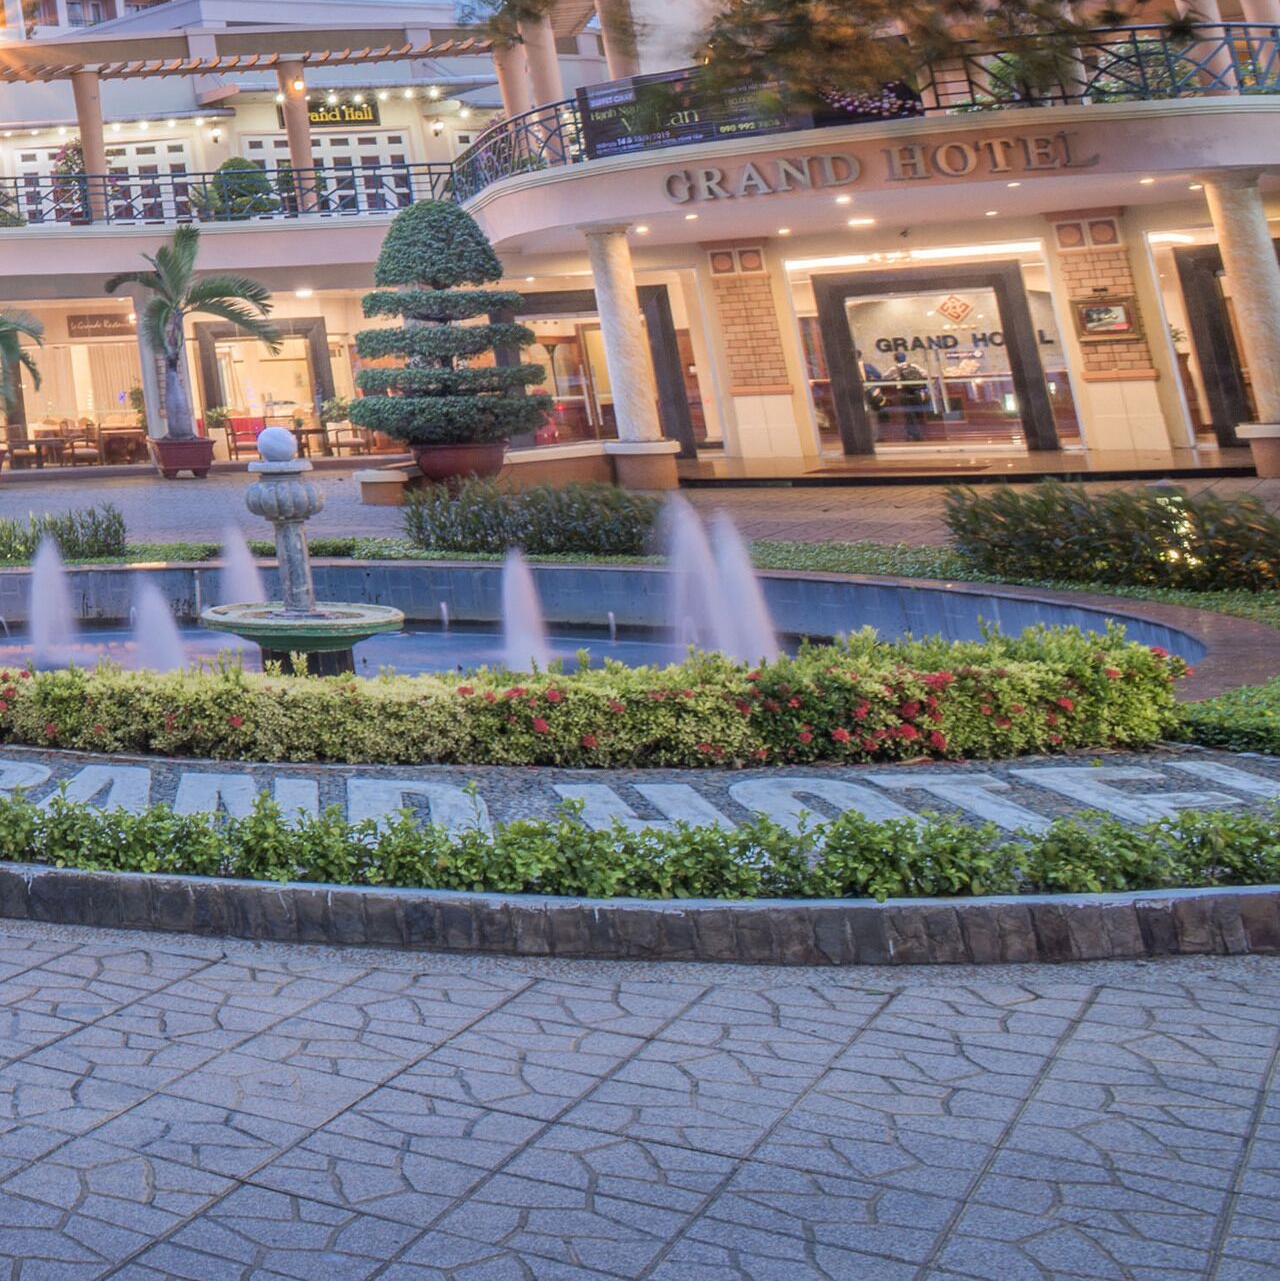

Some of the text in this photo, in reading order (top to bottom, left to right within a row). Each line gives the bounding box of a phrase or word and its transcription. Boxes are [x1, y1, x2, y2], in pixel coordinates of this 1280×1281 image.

[307, 108, 340, 122] and
[661, 130, 1101, 205] GRAND HOTEL
[875, 329, 1054, 353] GRAND HOL
